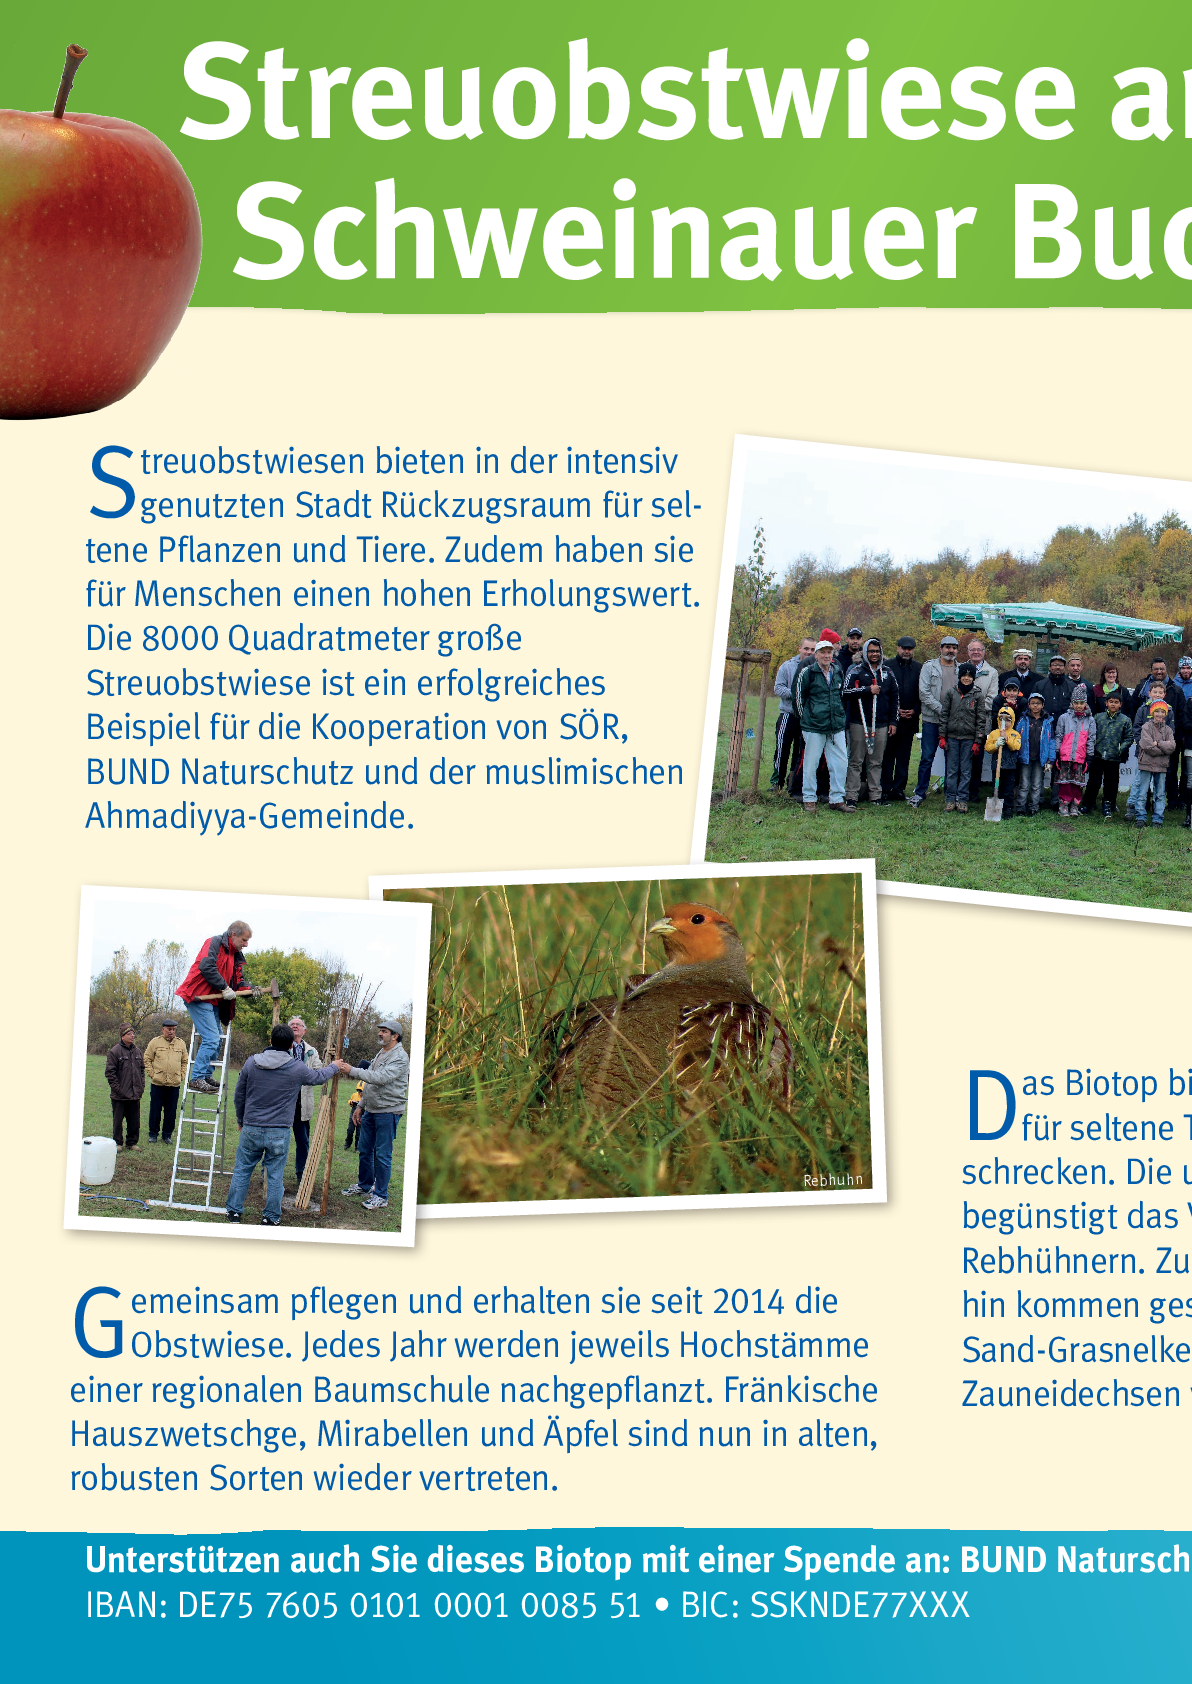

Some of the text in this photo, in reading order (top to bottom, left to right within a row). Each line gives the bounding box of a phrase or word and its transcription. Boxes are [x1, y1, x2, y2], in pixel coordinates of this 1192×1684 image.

[179, 38, 1075, 141] Streuobstwiese
[233, 178, 977, 281] Schweinauer
[86, 579, 699, 613] für Menschen einen hohen Erholungswert.
[88, 623, 521, 657] Die 8000 Quadratmeter große
[88, 757, 682, 785] BUND Naturschutz und der muslimischen
[85, 801, 413, 836] Ahmadiyya-Gemeinde.
[804, 1173, 863, 1187] Rebhuhn
[964, 1246, 1144, 1274] Rebhühnern.
[962, 1379, 1179, 1407] Zauneidechsen
[71, 1463, 557, 1491] robusten Sorten wieder vertreten.
[87, 1546, 279, 1573] Unterstützen
[291, 1544, 359, 1573] auch
[371, 1545, 417, 1573] Sie
[428, 1545, 524, 1573] dieses
[536, 1545, 631, 1580] Biotop
[643, 1545, 689, 1572] mit
[699, 1545, 774, 1573] einer
[784, 1545, 895, 1580] Spende
[906, 1553, 949, 1573] an:
[962, 1546, 1046, 1572] BUND
[88, 1591, 970, 1618] IBAN: DE75 7605 0101 0001 0085 51 BIC: SSKNDE77XXX
